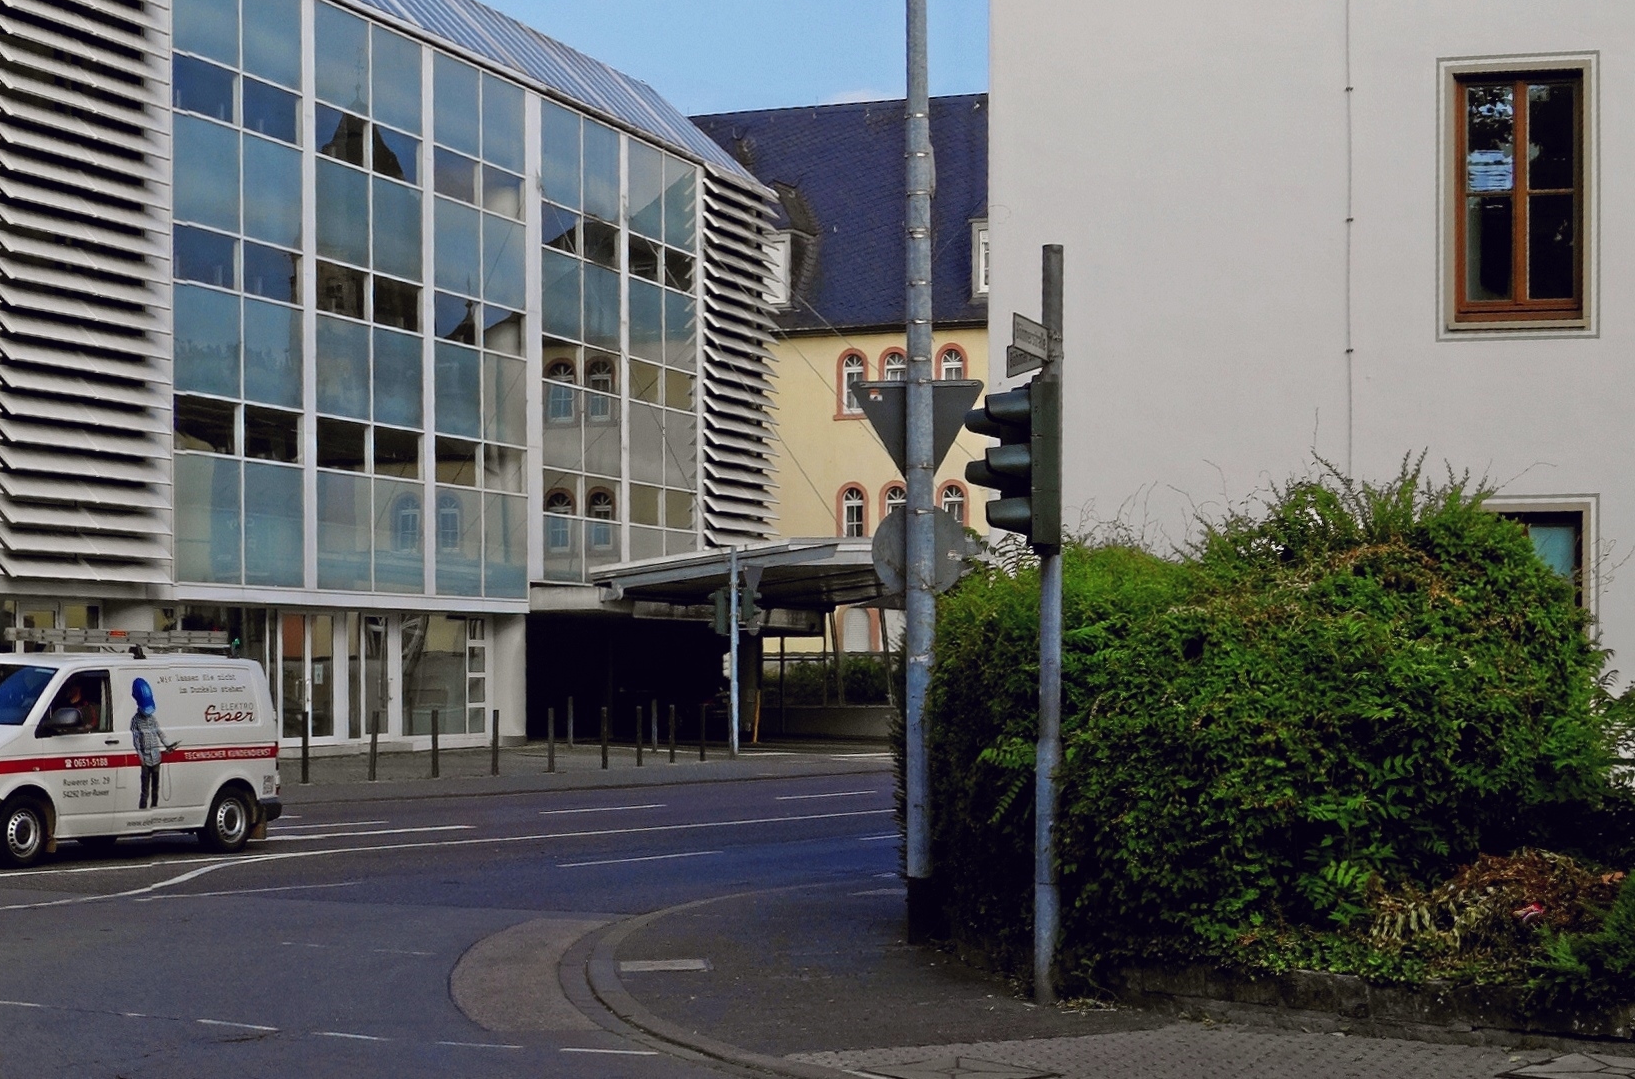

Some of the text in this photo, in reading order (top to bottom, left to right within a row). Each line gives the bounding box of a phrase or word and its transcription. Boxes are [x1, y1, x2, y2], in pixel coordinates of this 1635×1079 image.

[220, 702, 254, 711] ELEKTRO
[204, 704, 255, 722] Esser
[184, 748, 272, 760] TECHNISCHER KUNDENDIENST
